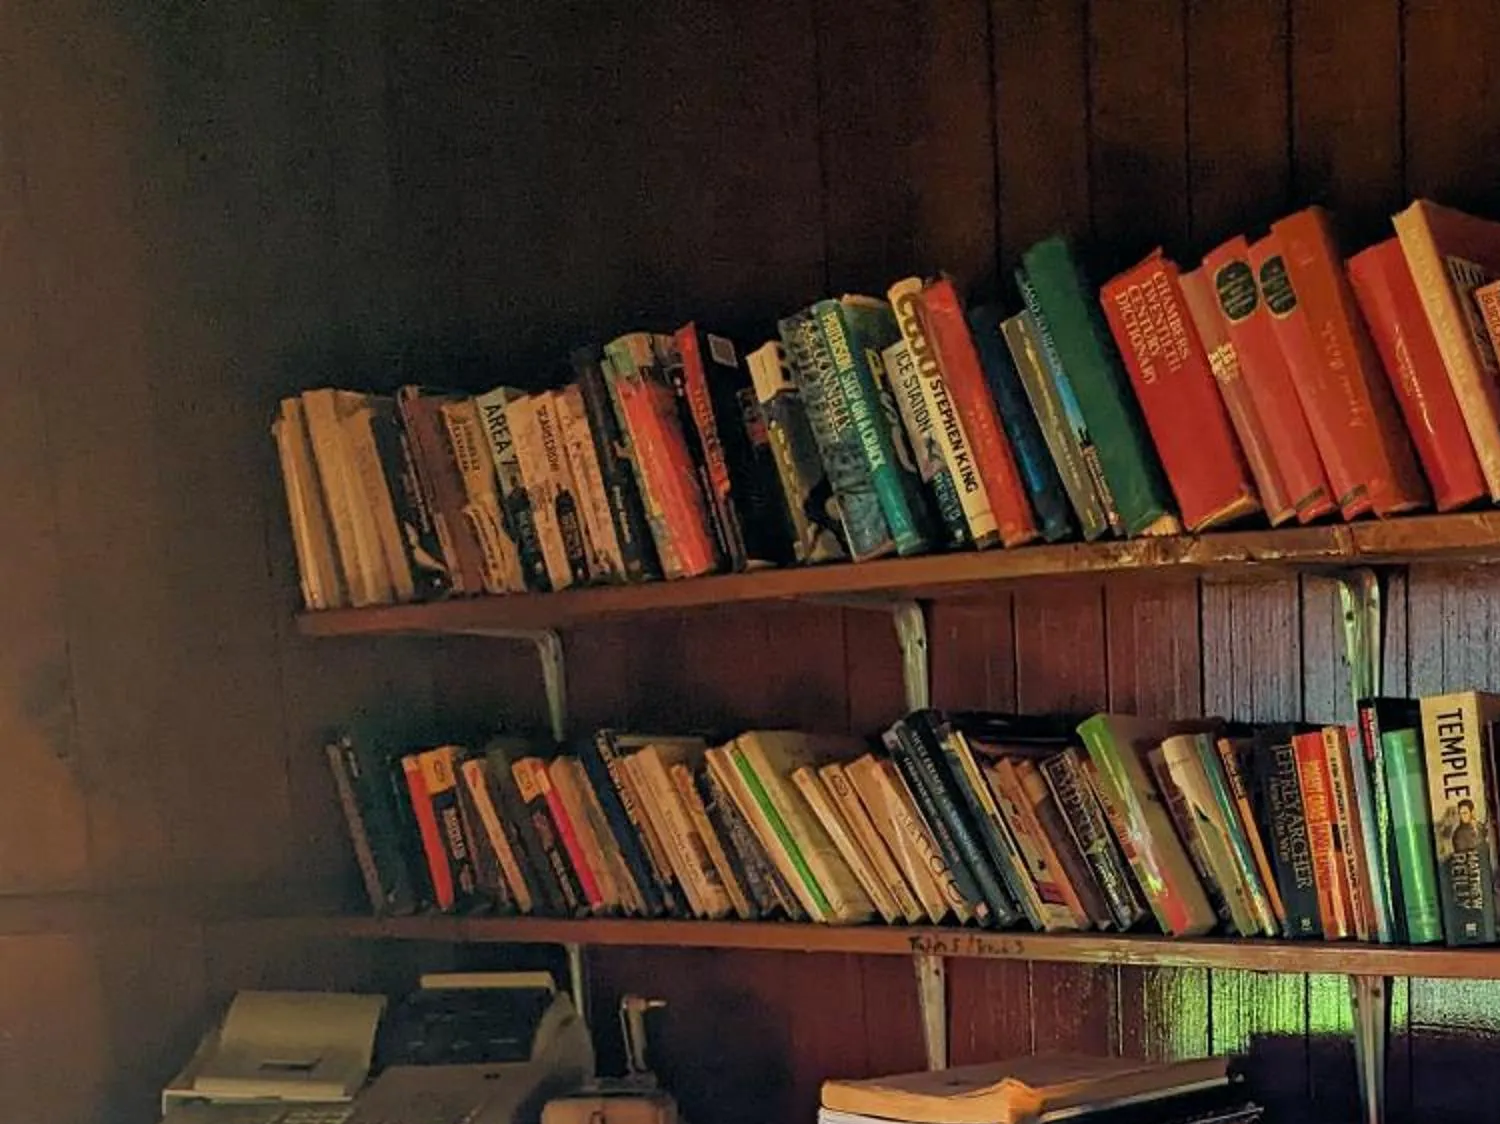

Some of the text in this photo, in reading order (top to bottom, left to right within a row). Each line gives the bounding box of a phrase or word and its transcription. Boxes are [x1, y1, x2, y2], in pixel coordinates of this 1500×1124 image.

[1115, 290, 1157, 385] DICTIONARY
[1127, 284, 1161, 357] CENTURY
[1141, 279, 1182, 373] TWENTIETH
[1153, 271, 1189, 361] CHAMBERS
[484, 404, 513, 455] AREA
[895, 348, 933, 437] ICE STATION
[929, 378, 966, 454] STEPHEN
[954, 451, 980, 494] KING
[1436, 707, 1472, 801] TEMPLE
[1270, 743, 1313, 890] JEFFREY ARCHER
